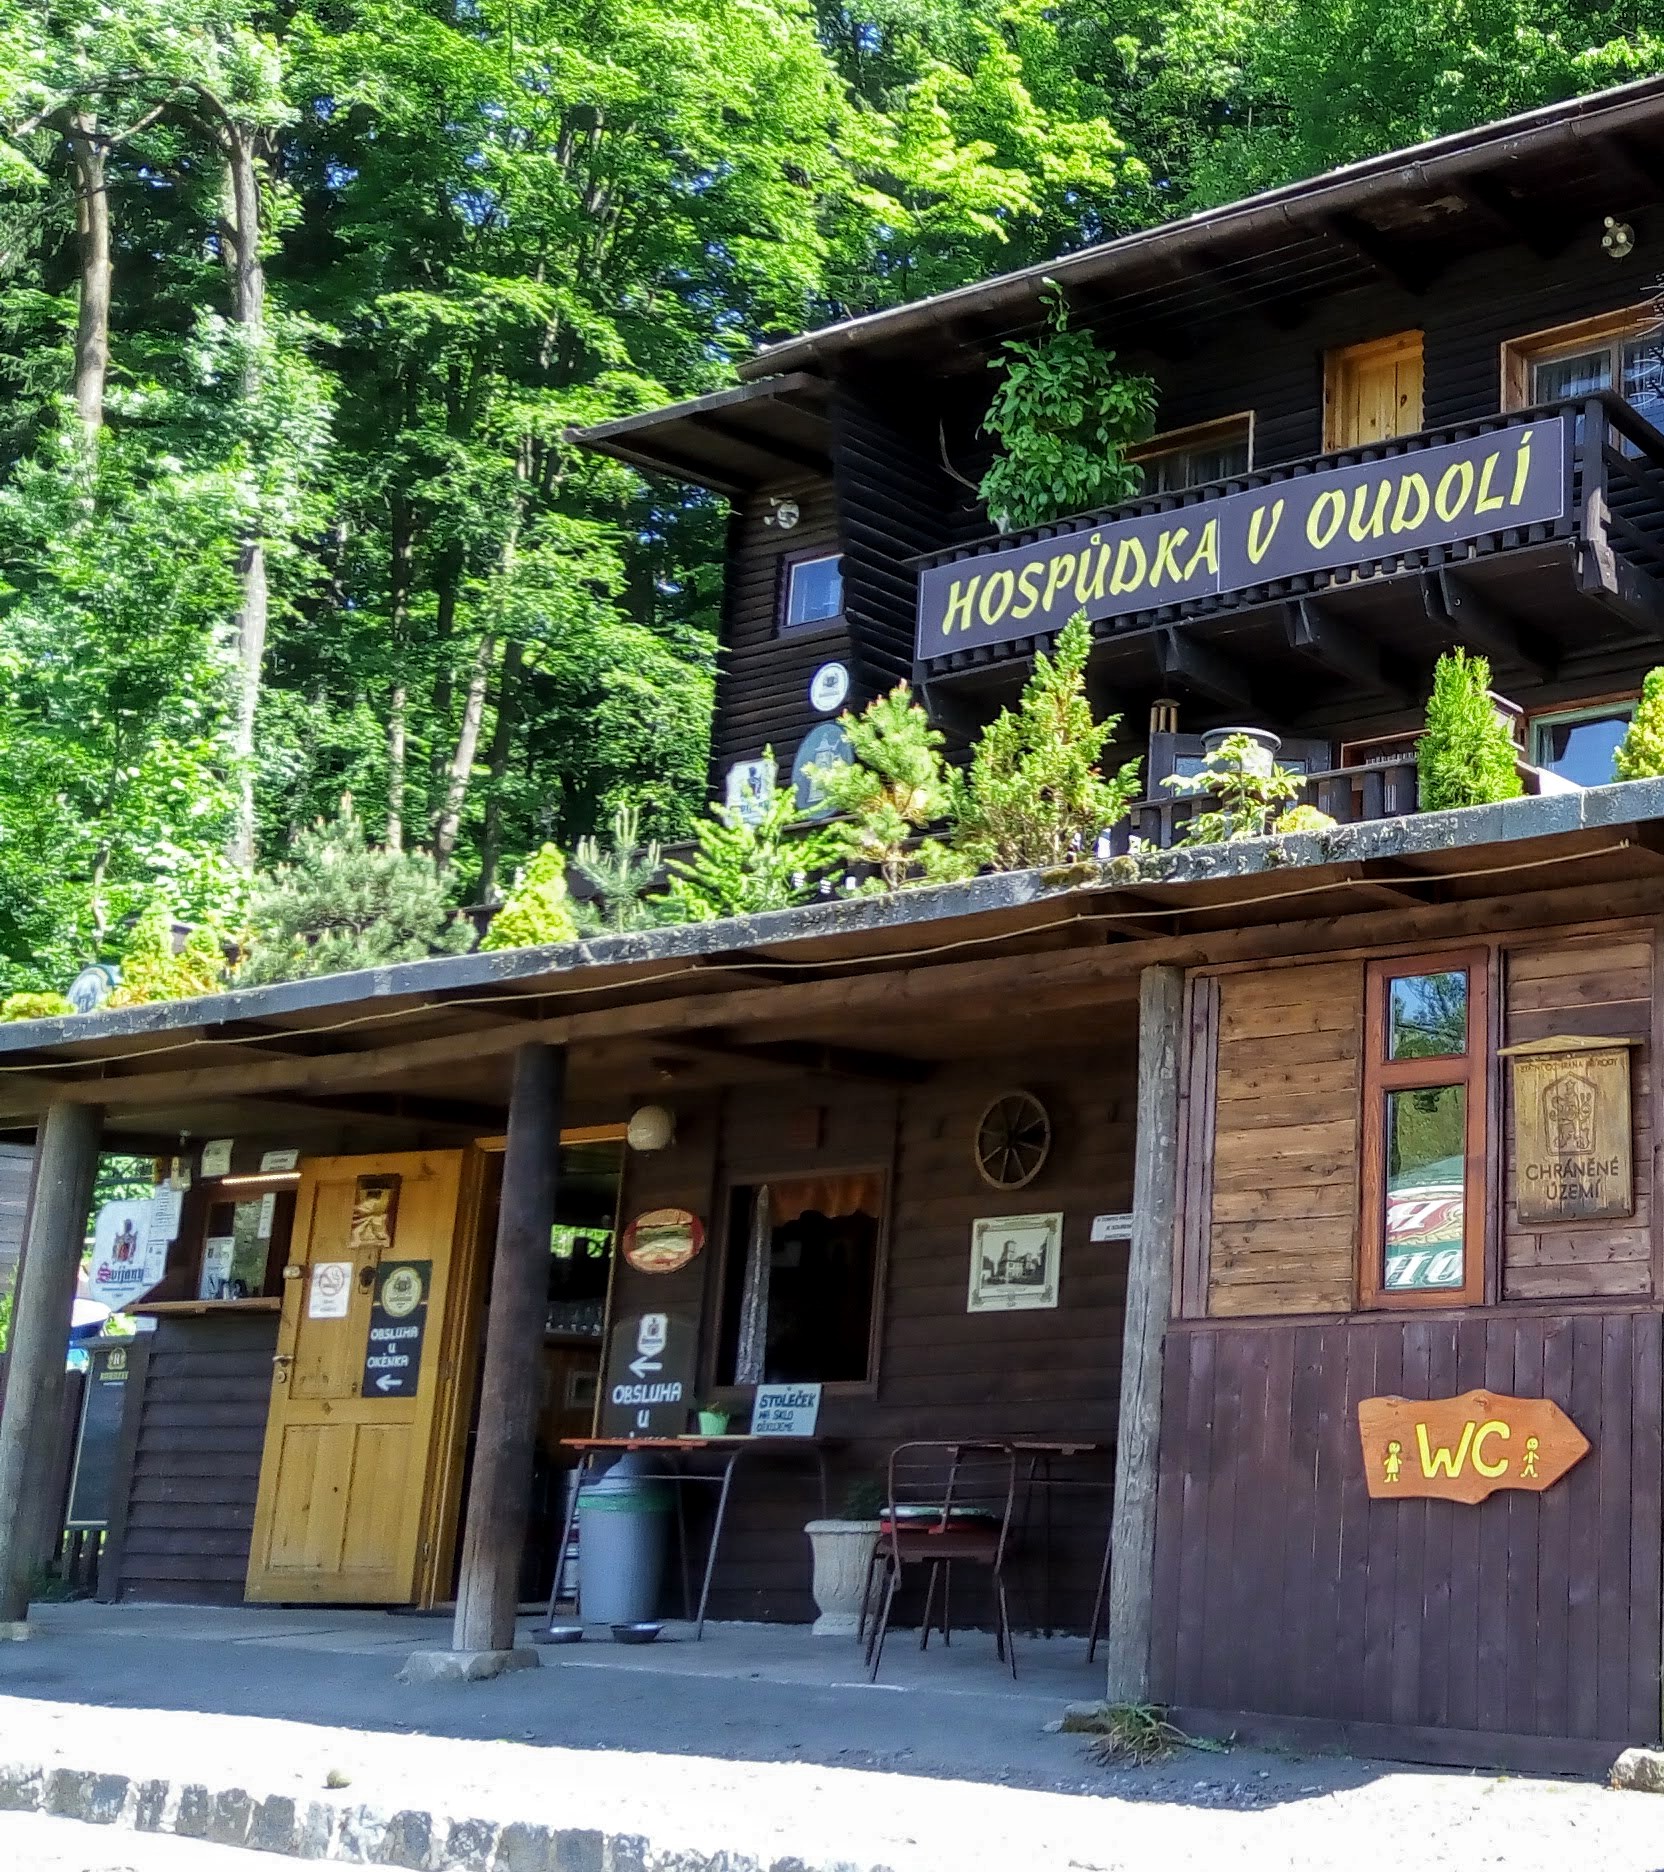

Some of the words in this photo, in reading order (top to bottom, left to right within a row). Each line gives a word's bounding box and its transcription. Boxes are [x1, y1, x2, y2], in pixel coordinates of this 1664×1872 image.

[942, 518, 1219, 636] HOSPŮDKA
[1247, 498, 1285, 565] V
[1306, 430, 1534, 550] OUDOLÍ
[1525, 1155, 1619, 1181] CHRÁNĚNÉ
[1546, 1179, 1601, 1200] ÚZEMÍ
[96, 1262, 144, 1284] Svijany
[370, 1325, 419, 1341] OBSLUHA
[612, 1381, 683, 1404] OBSLUHA
[1415, 1419, 1511, 1479] WC
